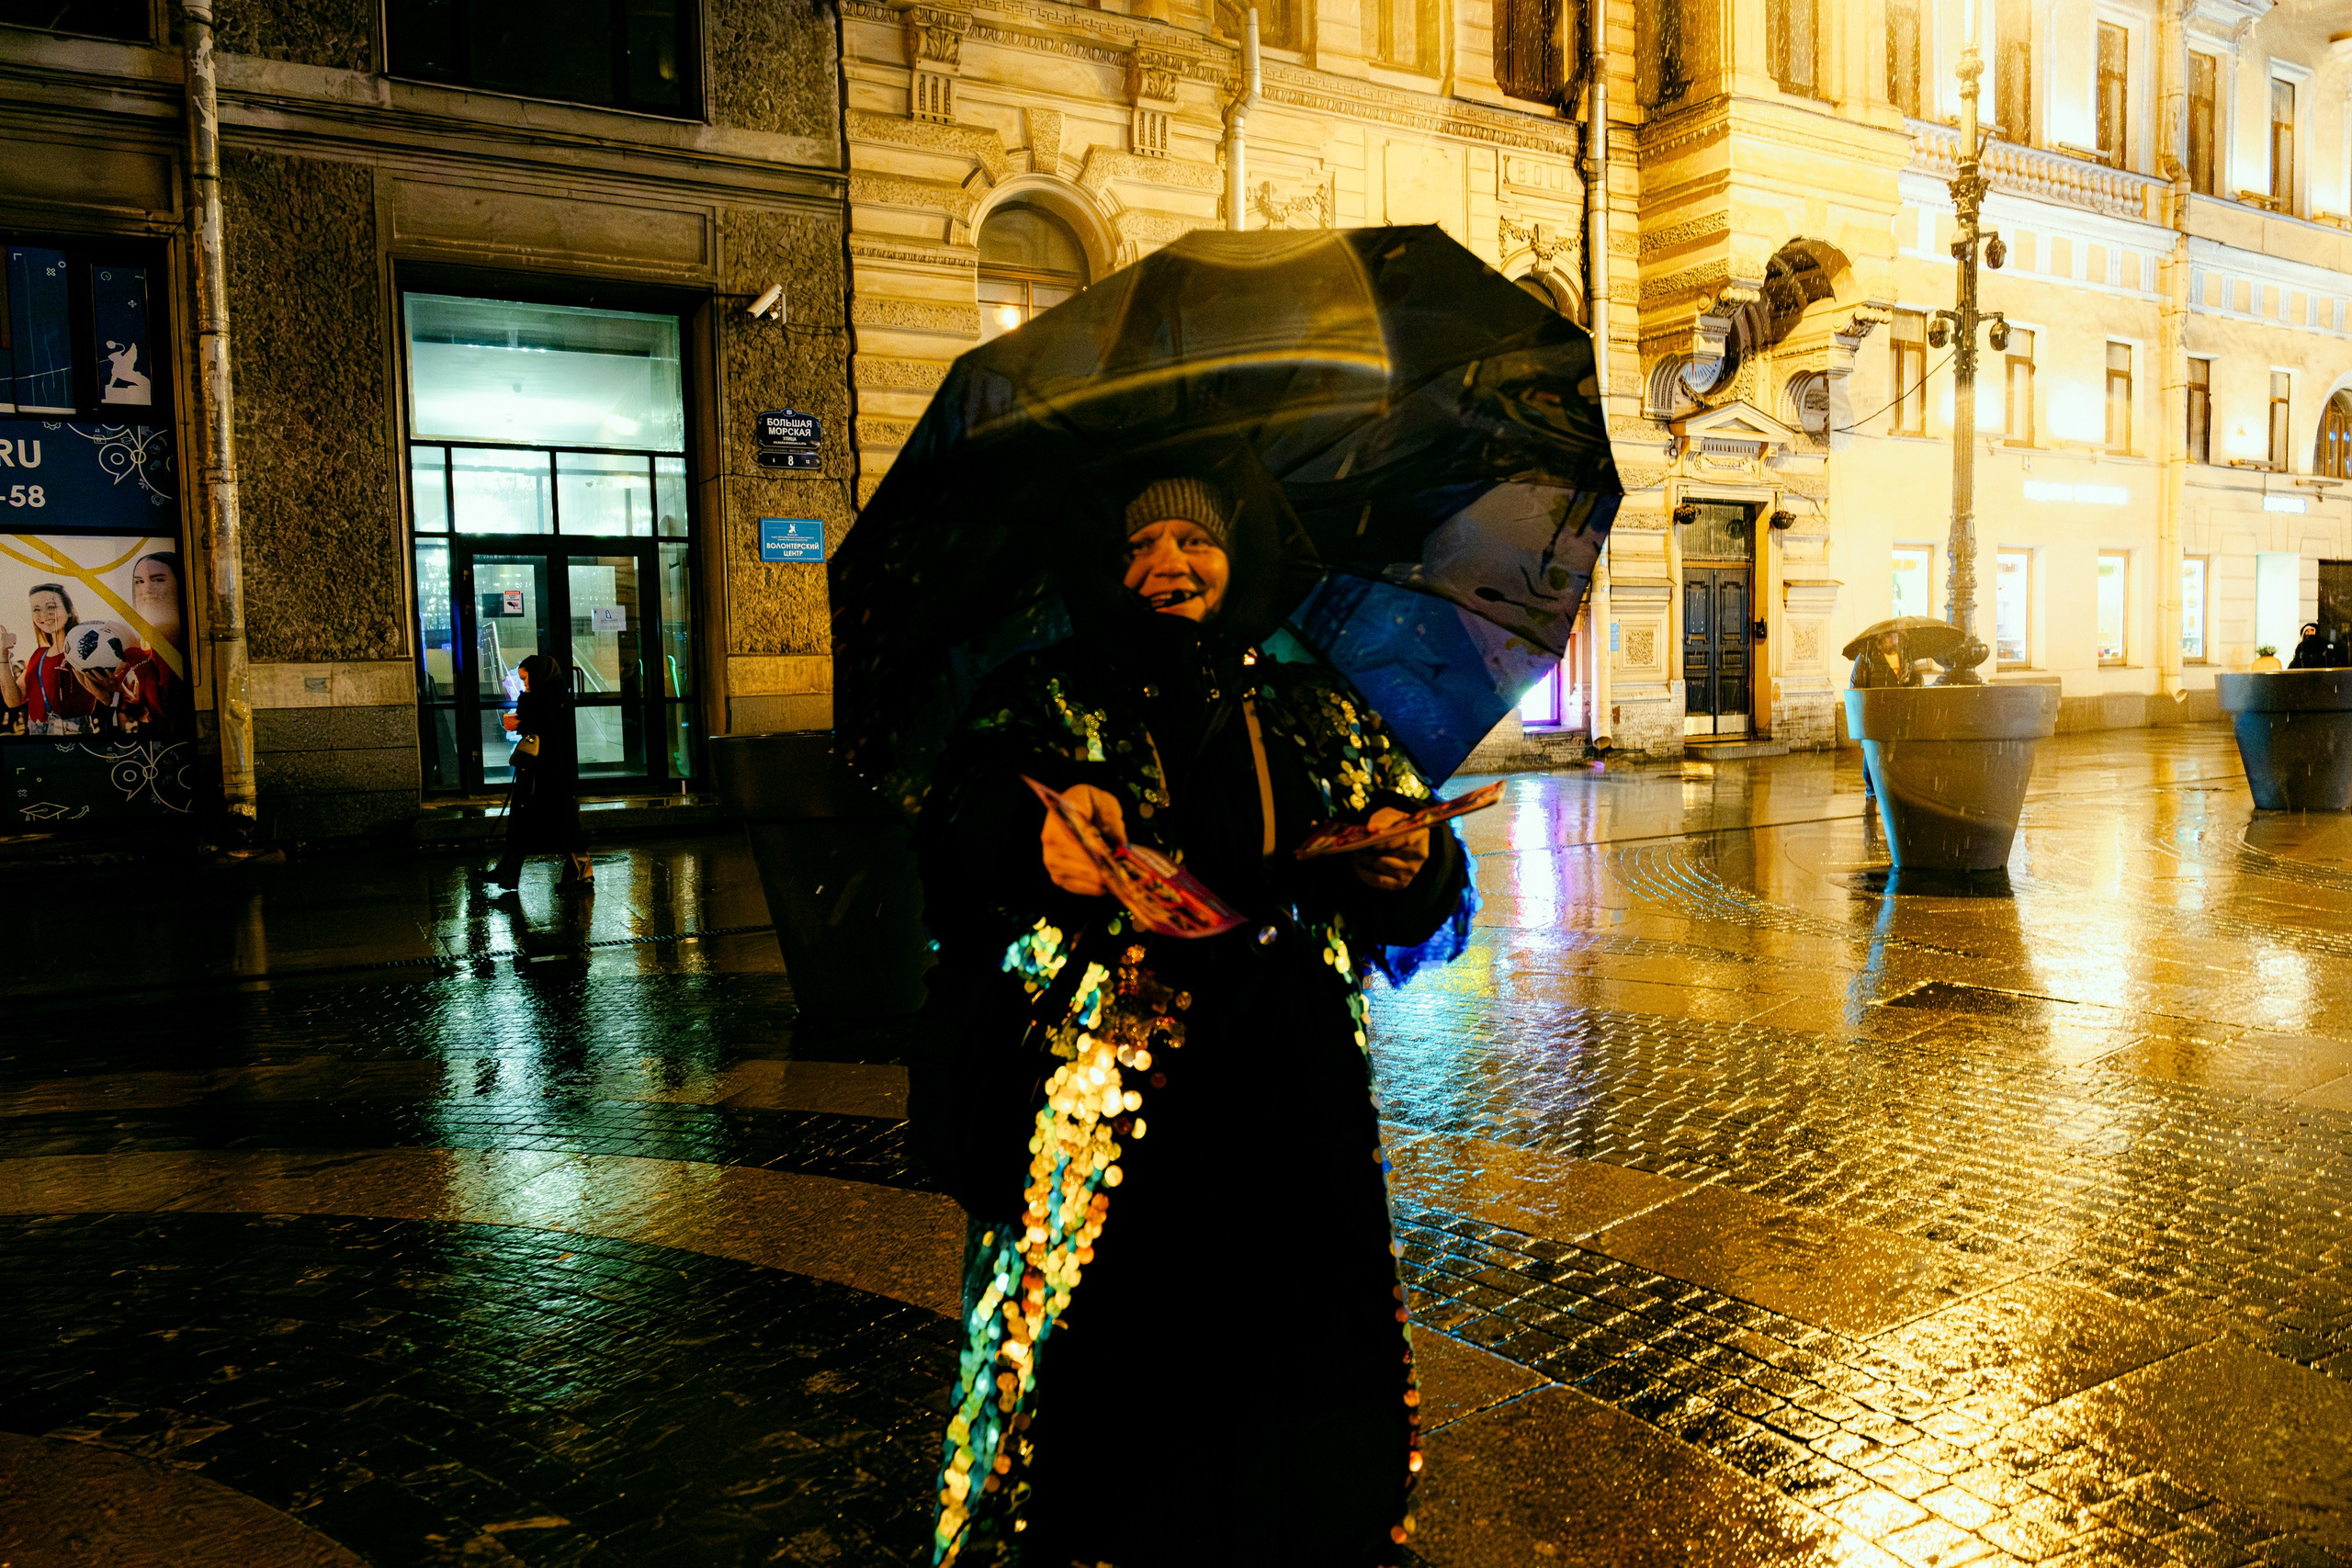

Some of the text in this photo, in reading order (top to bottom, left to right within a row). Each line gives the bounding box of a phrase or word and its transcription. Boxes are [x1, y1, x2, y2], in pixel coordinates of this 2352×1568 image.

[766, 417, 812, 428] БОЛЬШАЯ
[768, 426, 811, 437] МОРСКАЯ
[787, 455, 795, 467] 8
